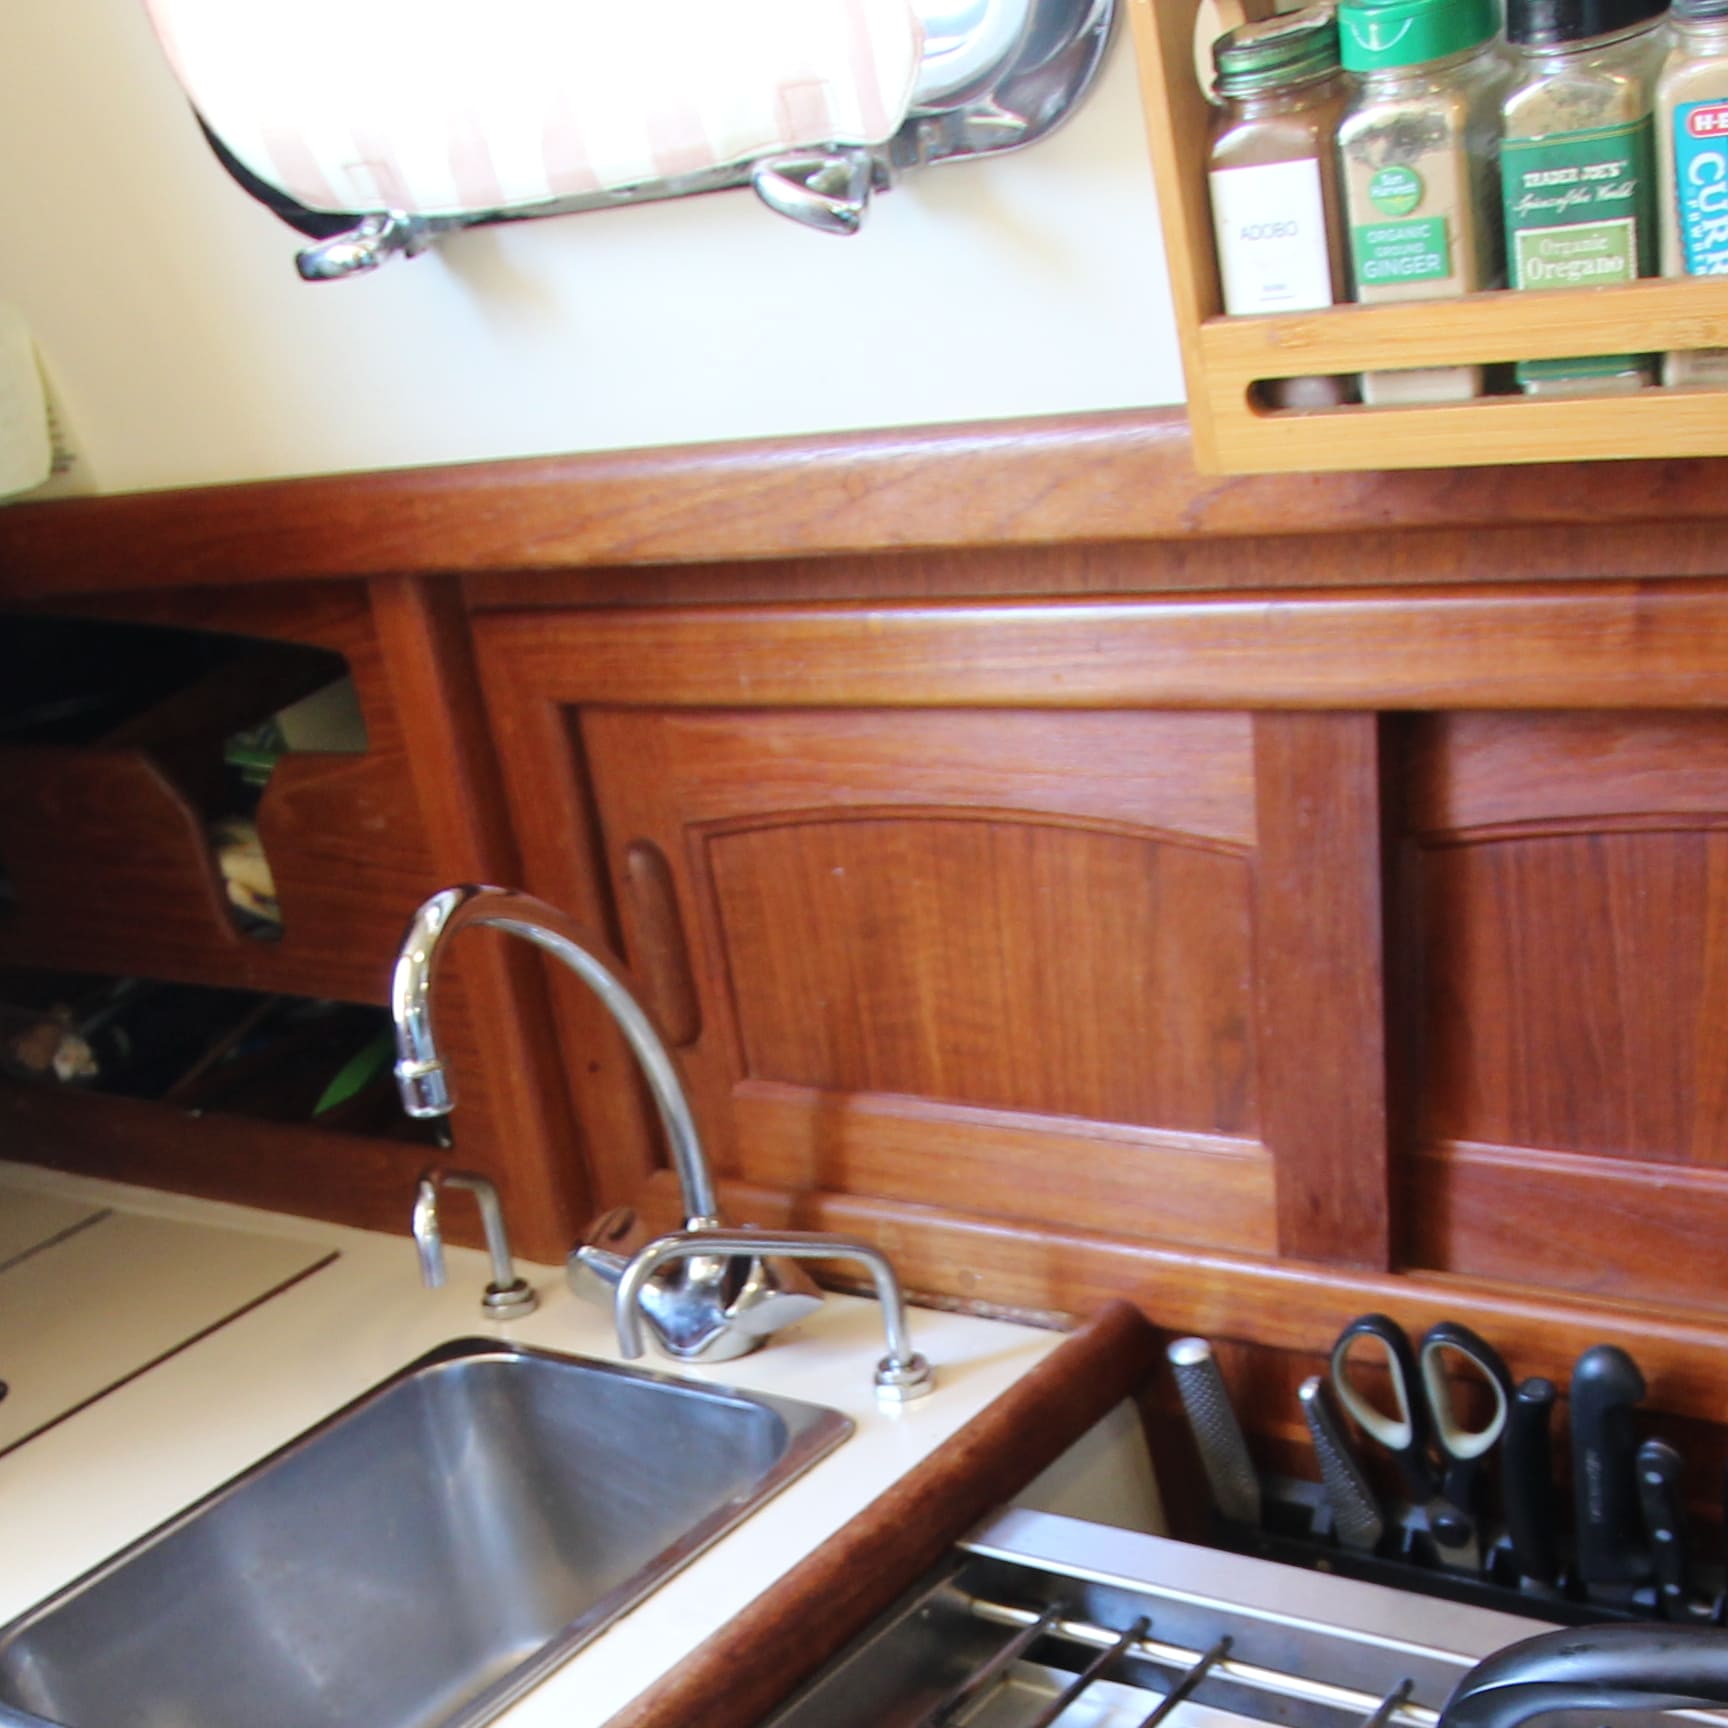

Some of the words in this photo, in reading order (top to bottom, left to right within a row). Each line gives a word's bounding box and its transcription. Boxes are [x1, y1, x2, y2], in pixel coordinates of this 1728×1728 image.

[1523, 168, 1579, 188] TRADER
[1240, 220, 1299, 241] ADOBO
[1367, 225, 1431, 243] ORGANIC
[1540, 234, 1608, 255] Organic
[1363, 253, 1442, 278] GINGER
[1526, 256, 1625, 280] Oregano
